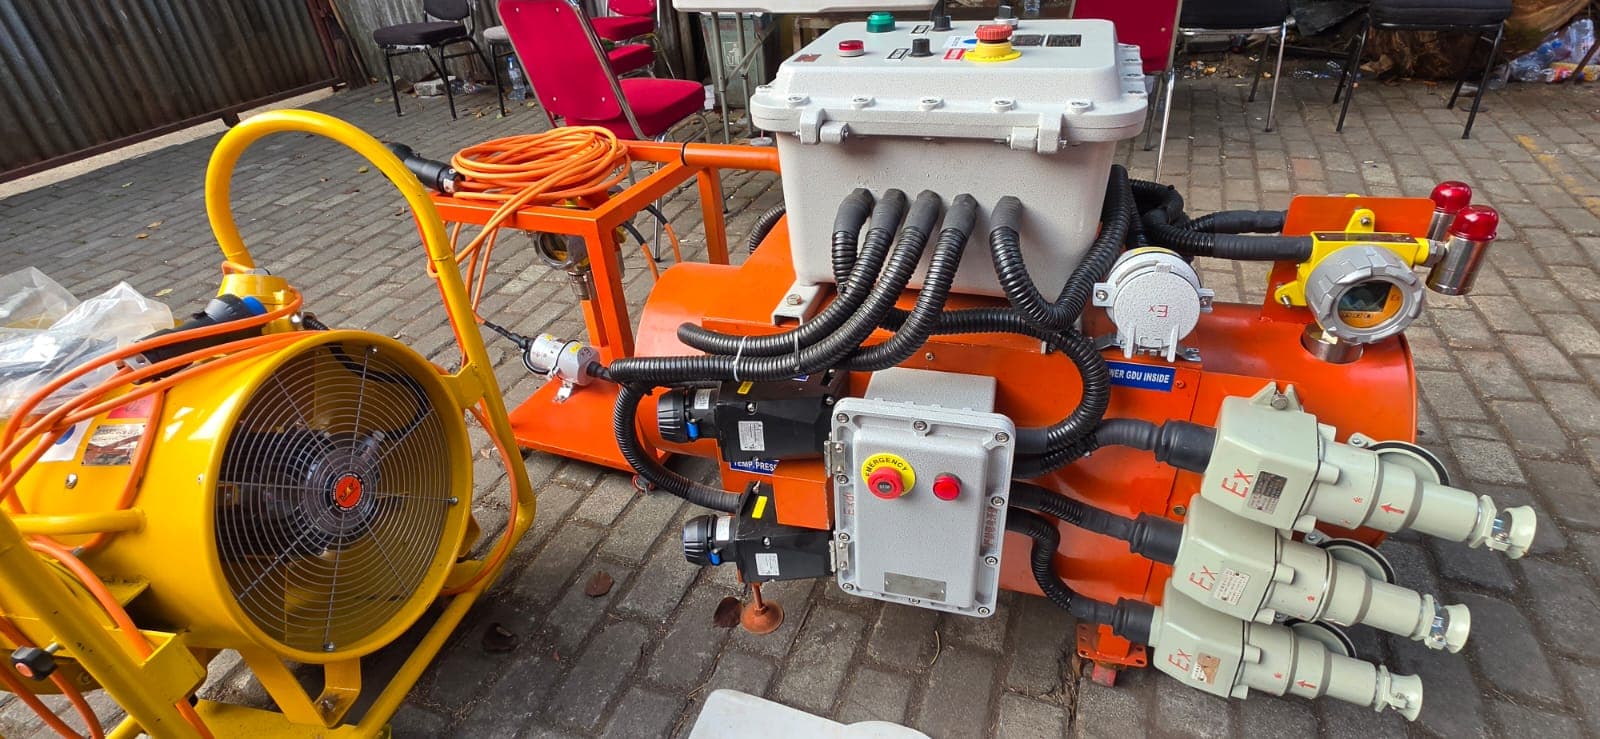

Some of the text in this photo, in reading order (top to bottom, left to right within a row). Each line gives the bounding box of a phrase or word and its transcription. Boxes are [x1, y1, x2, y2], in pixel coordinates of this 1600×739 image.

[1126, 370, 1143, 380] GDU
[1143, 372, 1170, 383] INSIDE
[866, 457, 908, 477] EMERGENCY
